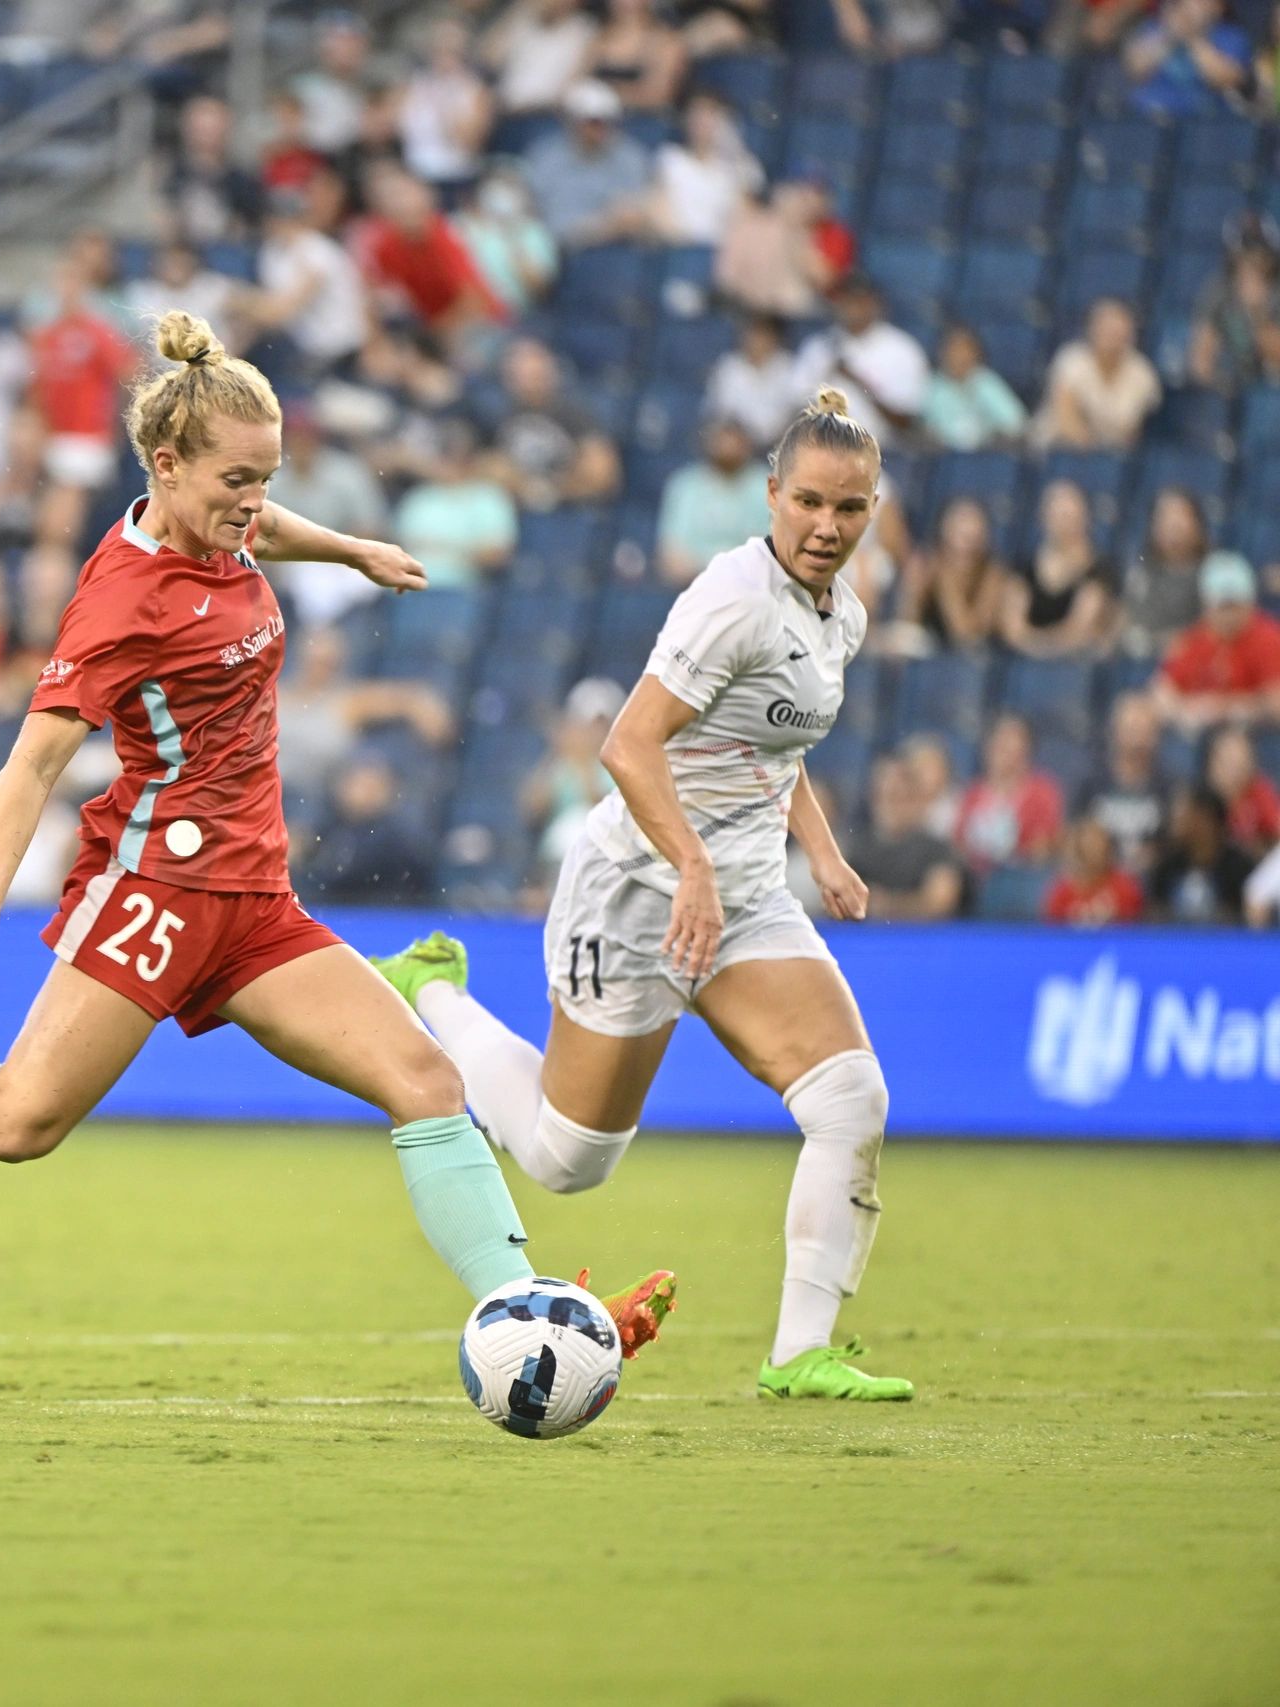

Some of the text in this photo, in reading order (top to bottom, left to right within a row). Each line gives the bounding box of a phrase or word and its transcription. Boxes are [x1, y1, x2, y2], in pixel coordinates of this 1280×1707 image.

[242, 622, 273, 658] Saint
[95, 892, 186, 982] 25
[569, 935, 603, 1000] 11
